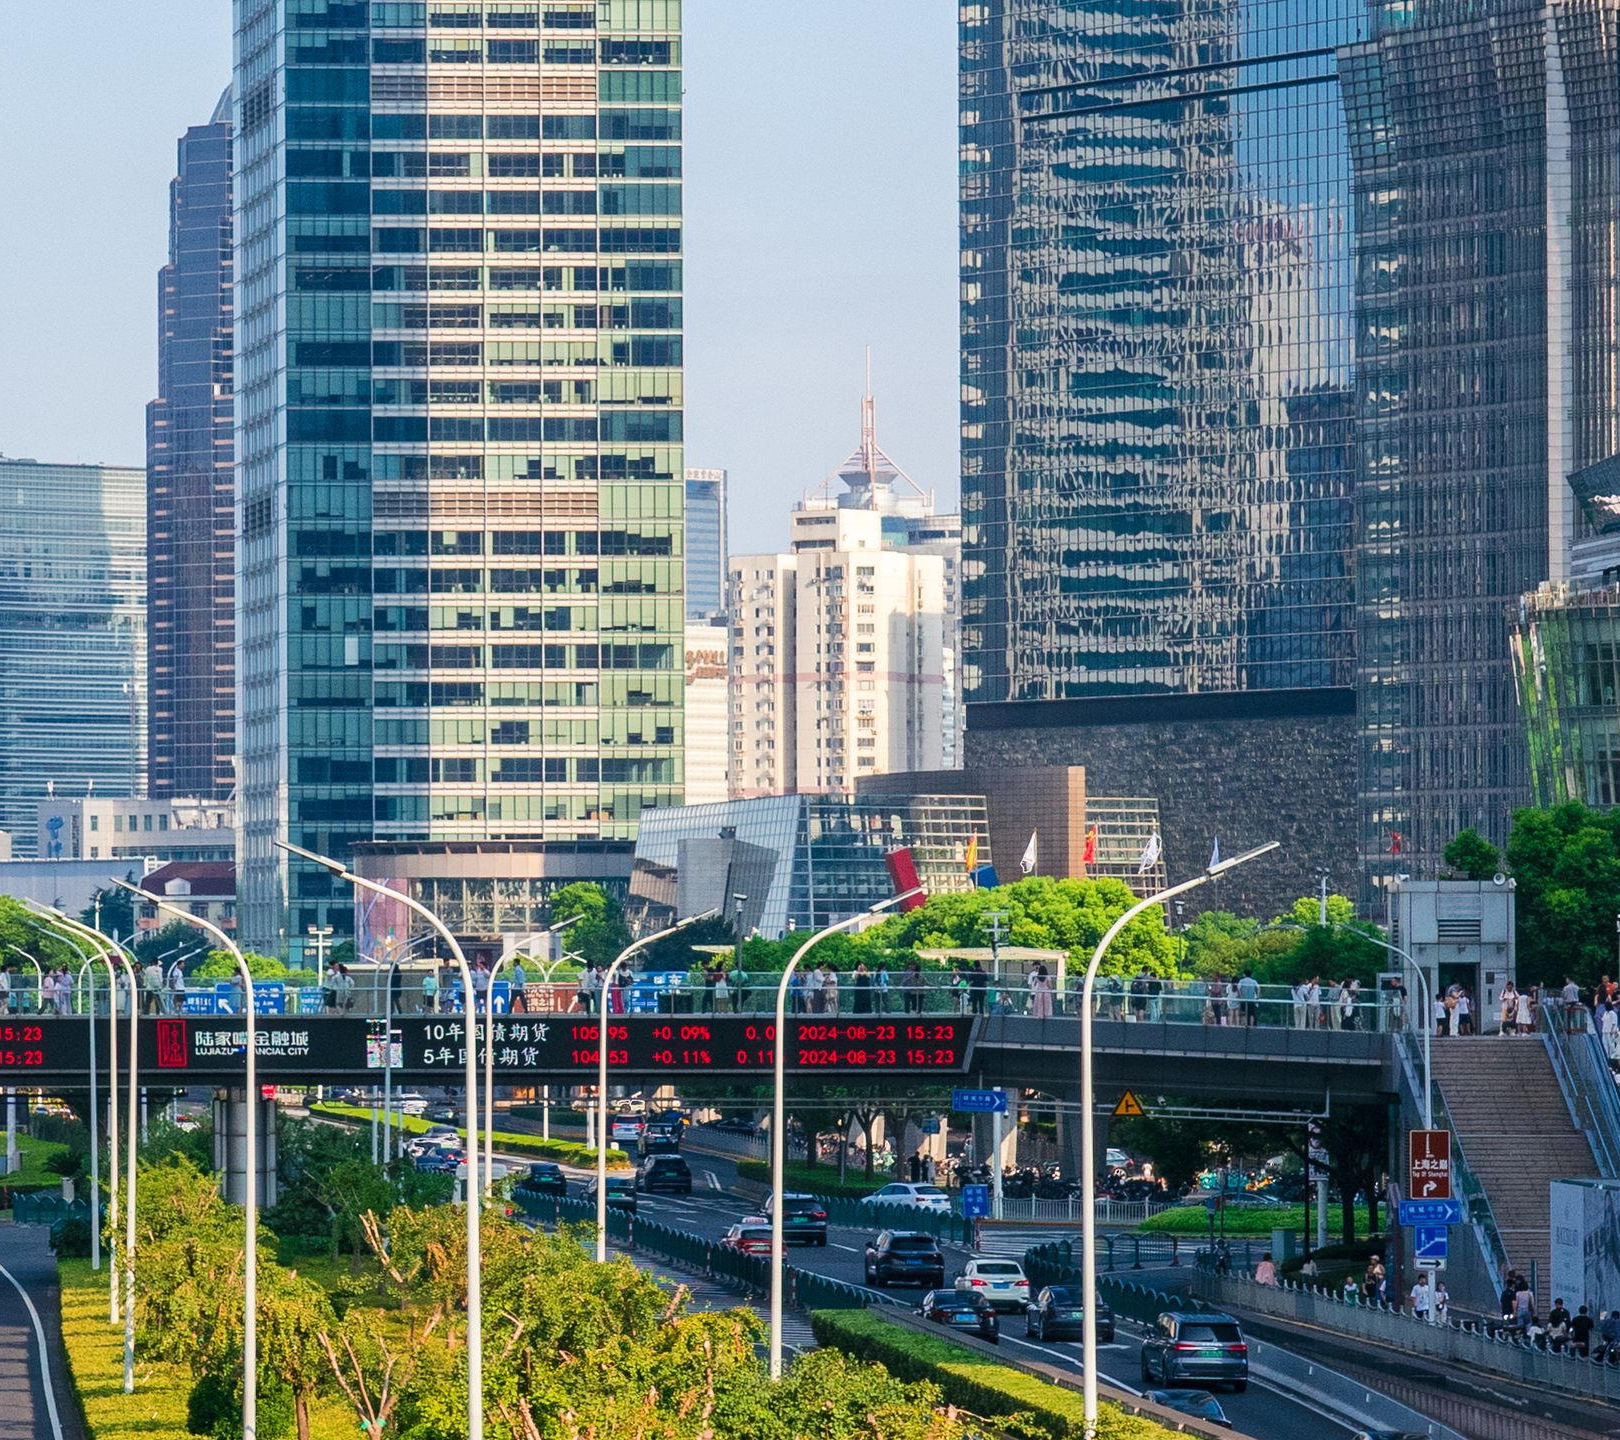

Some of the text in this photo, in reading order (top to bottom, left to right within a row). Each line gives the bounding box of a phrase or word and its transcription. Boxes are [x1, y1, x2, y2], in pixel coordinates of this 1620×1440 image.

[572, 1025, 629, 1041] 10595
[652, 1025, 711, 1041] +0.09%
[745, 1025, 776, 1041] 0.0
[798, 1025, 896, 1041] 2024-08-23
[906, 1025, 955, 1041] 15:23
[195, 1047, 236, 1056] LUJIAZU
[287, 1047, 309, 1056] CITY
[572, 1049, 629, 1065] 10453
[652, 1049, 711, 1065] +0.11%
[736, 1049, 775, 1065] 0.11
[798, 1049, 896, 1065] 2024-08-23
[906, 1049, 955, 1065] 15:23
